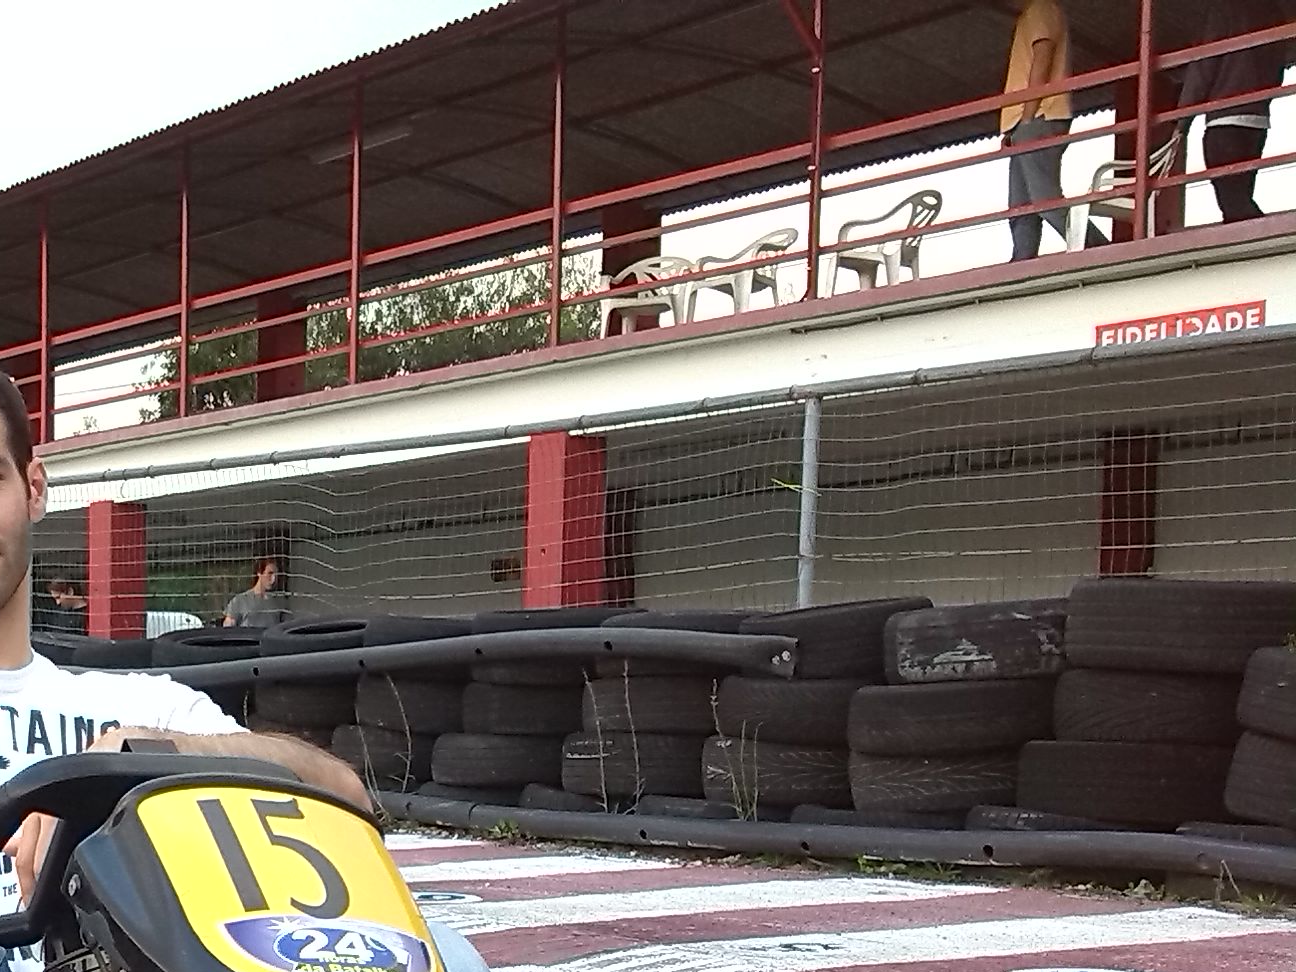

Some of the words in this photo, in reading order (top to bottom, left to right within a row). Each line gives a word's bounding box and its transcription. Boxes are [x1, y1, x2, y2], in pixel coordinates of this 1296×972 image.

[196, 797, 350, 919] 15
[2, 882, 18, 897] THE
[291, 929, 375, 962] 24
